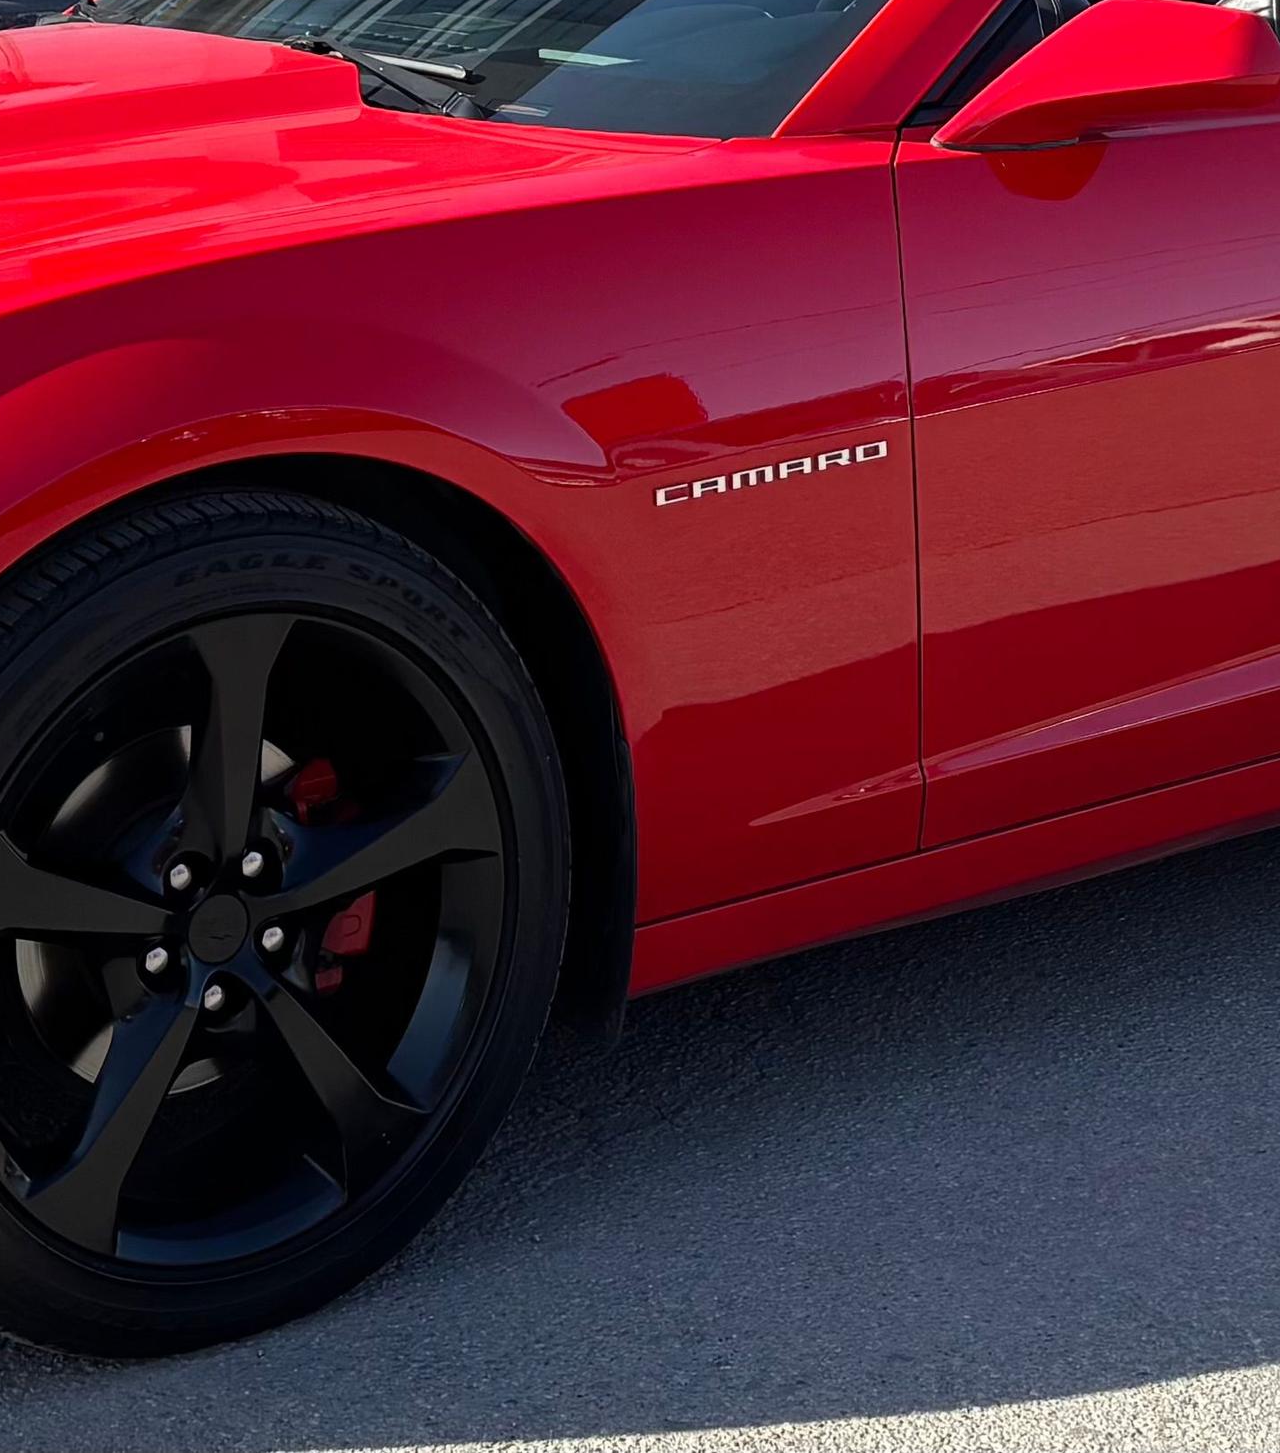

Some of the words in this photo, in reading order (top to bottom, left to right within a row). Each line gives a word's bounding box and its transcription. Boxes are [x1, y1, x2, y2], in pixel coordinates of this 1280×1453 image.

[655, 440, 888, 507] CAMARO
[173, 552, 329, 588] EAGLE
[346, 561, 472, 642] SPORT
